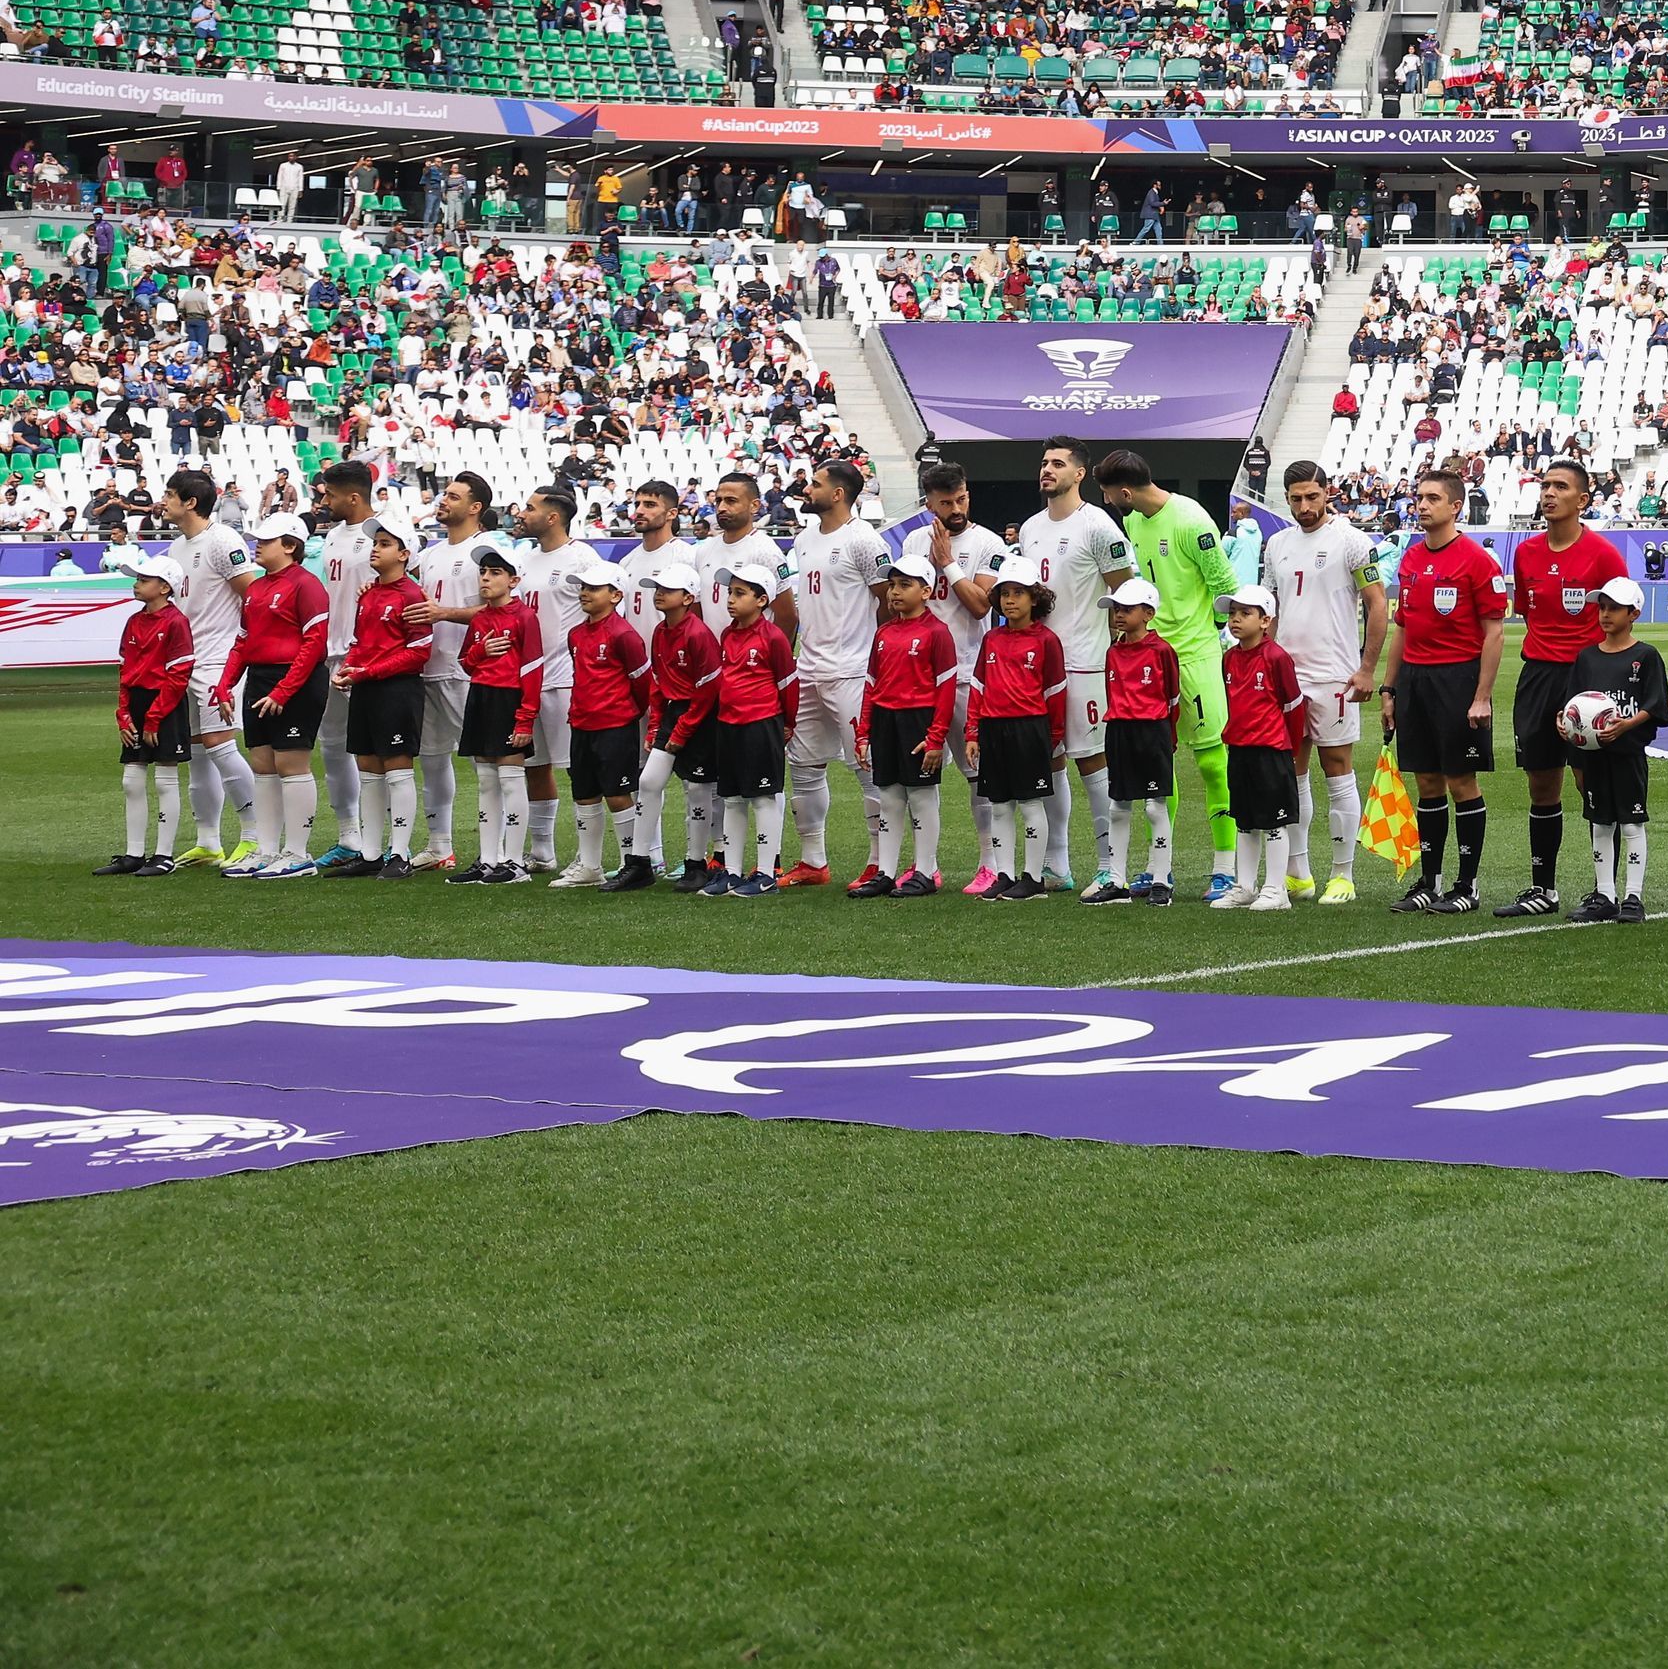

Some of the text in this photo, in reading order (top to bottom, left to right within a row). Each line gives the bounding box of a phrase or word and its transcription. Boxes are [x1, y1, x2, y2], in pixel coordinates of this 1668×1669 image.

[36, 78, 224, 106] Education City Stadium
[702, 118, 820, 137] #AsianCup2023
[1295, 129, 1348, 143] ASIAN
[1350, 129, 1387, 143] CUP
[1399, 129, 1452, 146] QATAR
[1580, 127, 1616, 143] 2023
[1021, 394, 1162, 404] ASIAN CUP
[1028, 402, 1100, 411] QATAR
[329, 559, 342, 582] 21
[1041, 558, 1050, 583] 6
[1147, 560, 1156, 583] 1
[434, 579, 443, 603] 4
[712, 581, 720, 605] 8
[806, 571, 821, 595] 13
[1293, 571, 1303, 596] 7
[1436, 589, 1455, 597] FIFA
[1564, 589, 1583, 598] FIFA
[633, 591, 642, 615] 5
[1087, 700, 1098, 725] 6
